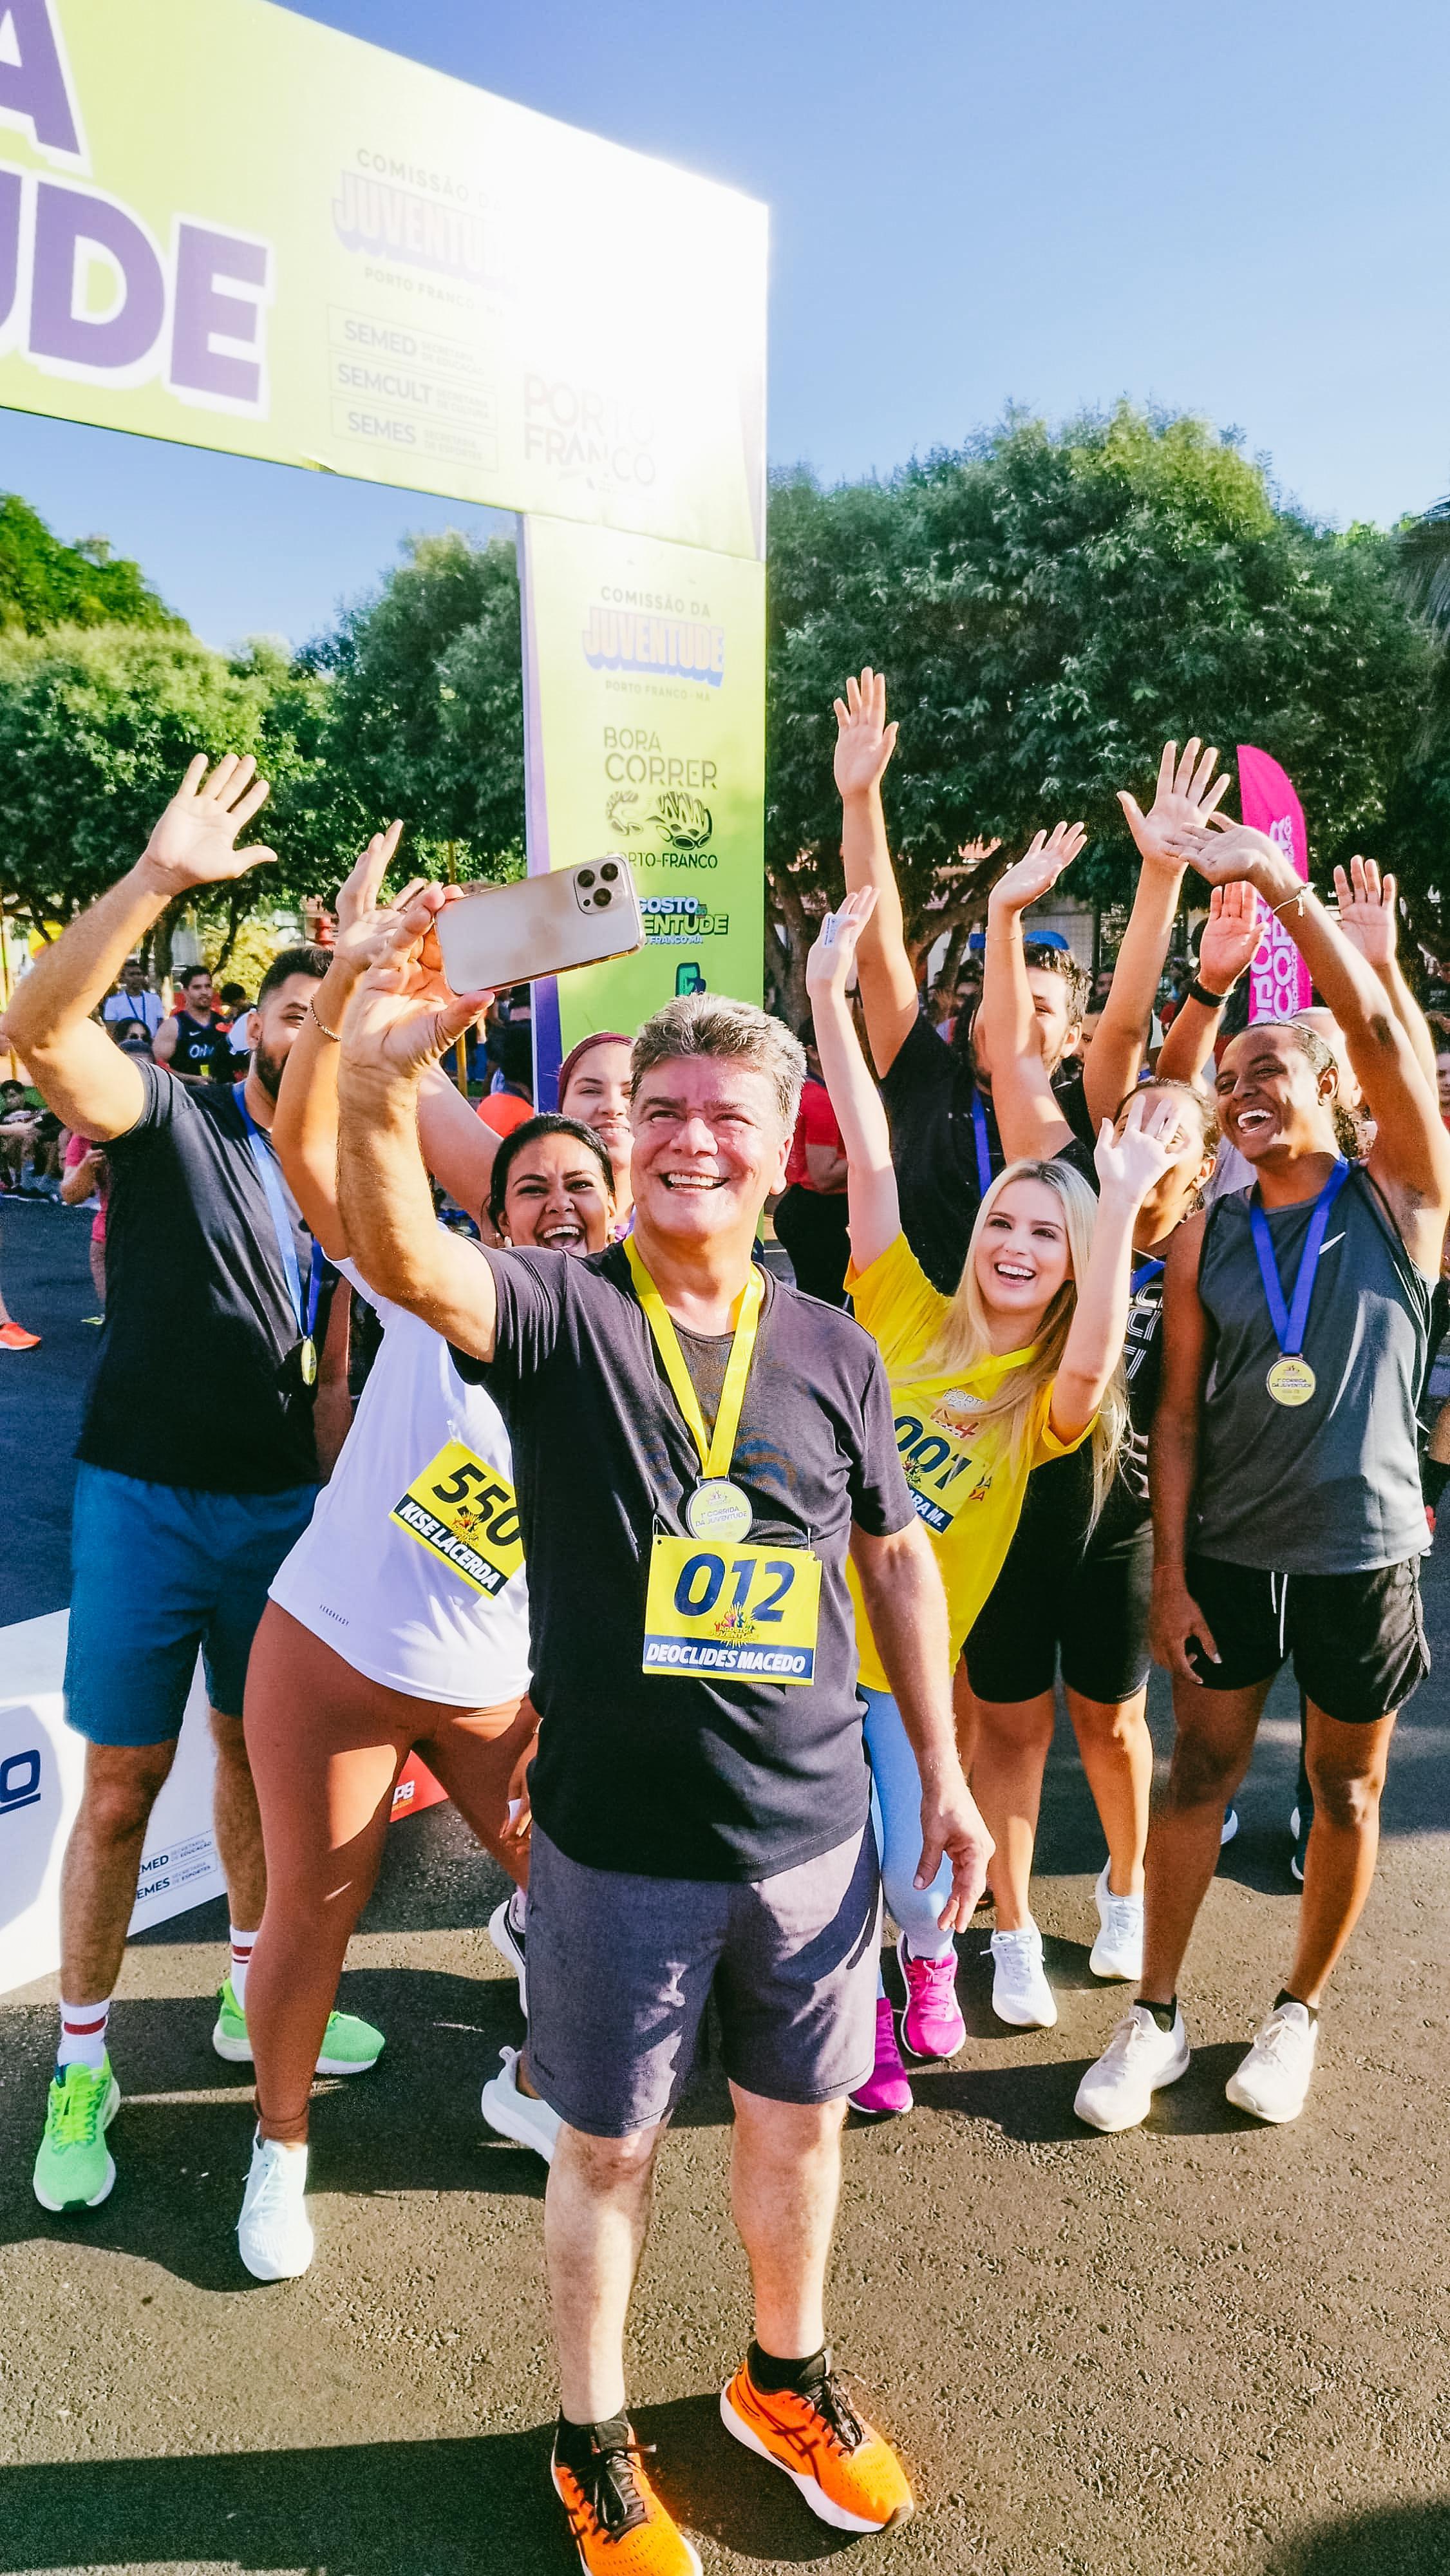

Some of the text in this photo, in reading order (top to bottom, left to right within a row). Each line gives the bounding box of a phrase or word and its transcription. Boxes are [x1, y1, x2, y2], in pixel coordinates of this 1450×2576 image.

[357, 147, 469, 202] COMISSÃO
[0, 169, 268, 404] DE
[364, 266, 413, 292] PORTO
[417, 281, 475, 310] FRANCO
[343, 318, 418, 357] SEMED
[337, 362, 433, 405] SEMCULT
[523, 371, 655, 446] PORTO
[346, 410, 417, 446] SEMES
[523, 421, 656, 488] FRANCO
[601, 585, 711, 618] COMISSÃO DA
[582, 606, 725, 685] JUVENTUDE
[605, 679, 642, 694] PORTO
[645, 685, 688, 701] FRANCO
[695, 691, 711, 703] MA
[603, 726, 662, 753] BORA
[604, 753, 718, 790] CORRER
[608, 851, 719, 869] RTO-FRANCO
[637, 896, 699, 914] GOSTO
[644, 914, 729, 936] ENTUDE
[650, 935, 688, 945] FRANCO
[431, 1462, 521, 1547] 550
[707, 1506, 740, 1518] CORRIDA
[432, 1528, 501, 1591] LACERDA
[673, 1553, 796, 1623] 012
[646, 1642, 806, 1674] DEOCLIDES MACEDO
[140, 1855, 169, 1874] MED
[136, 1877, 171, 1900] EMES
